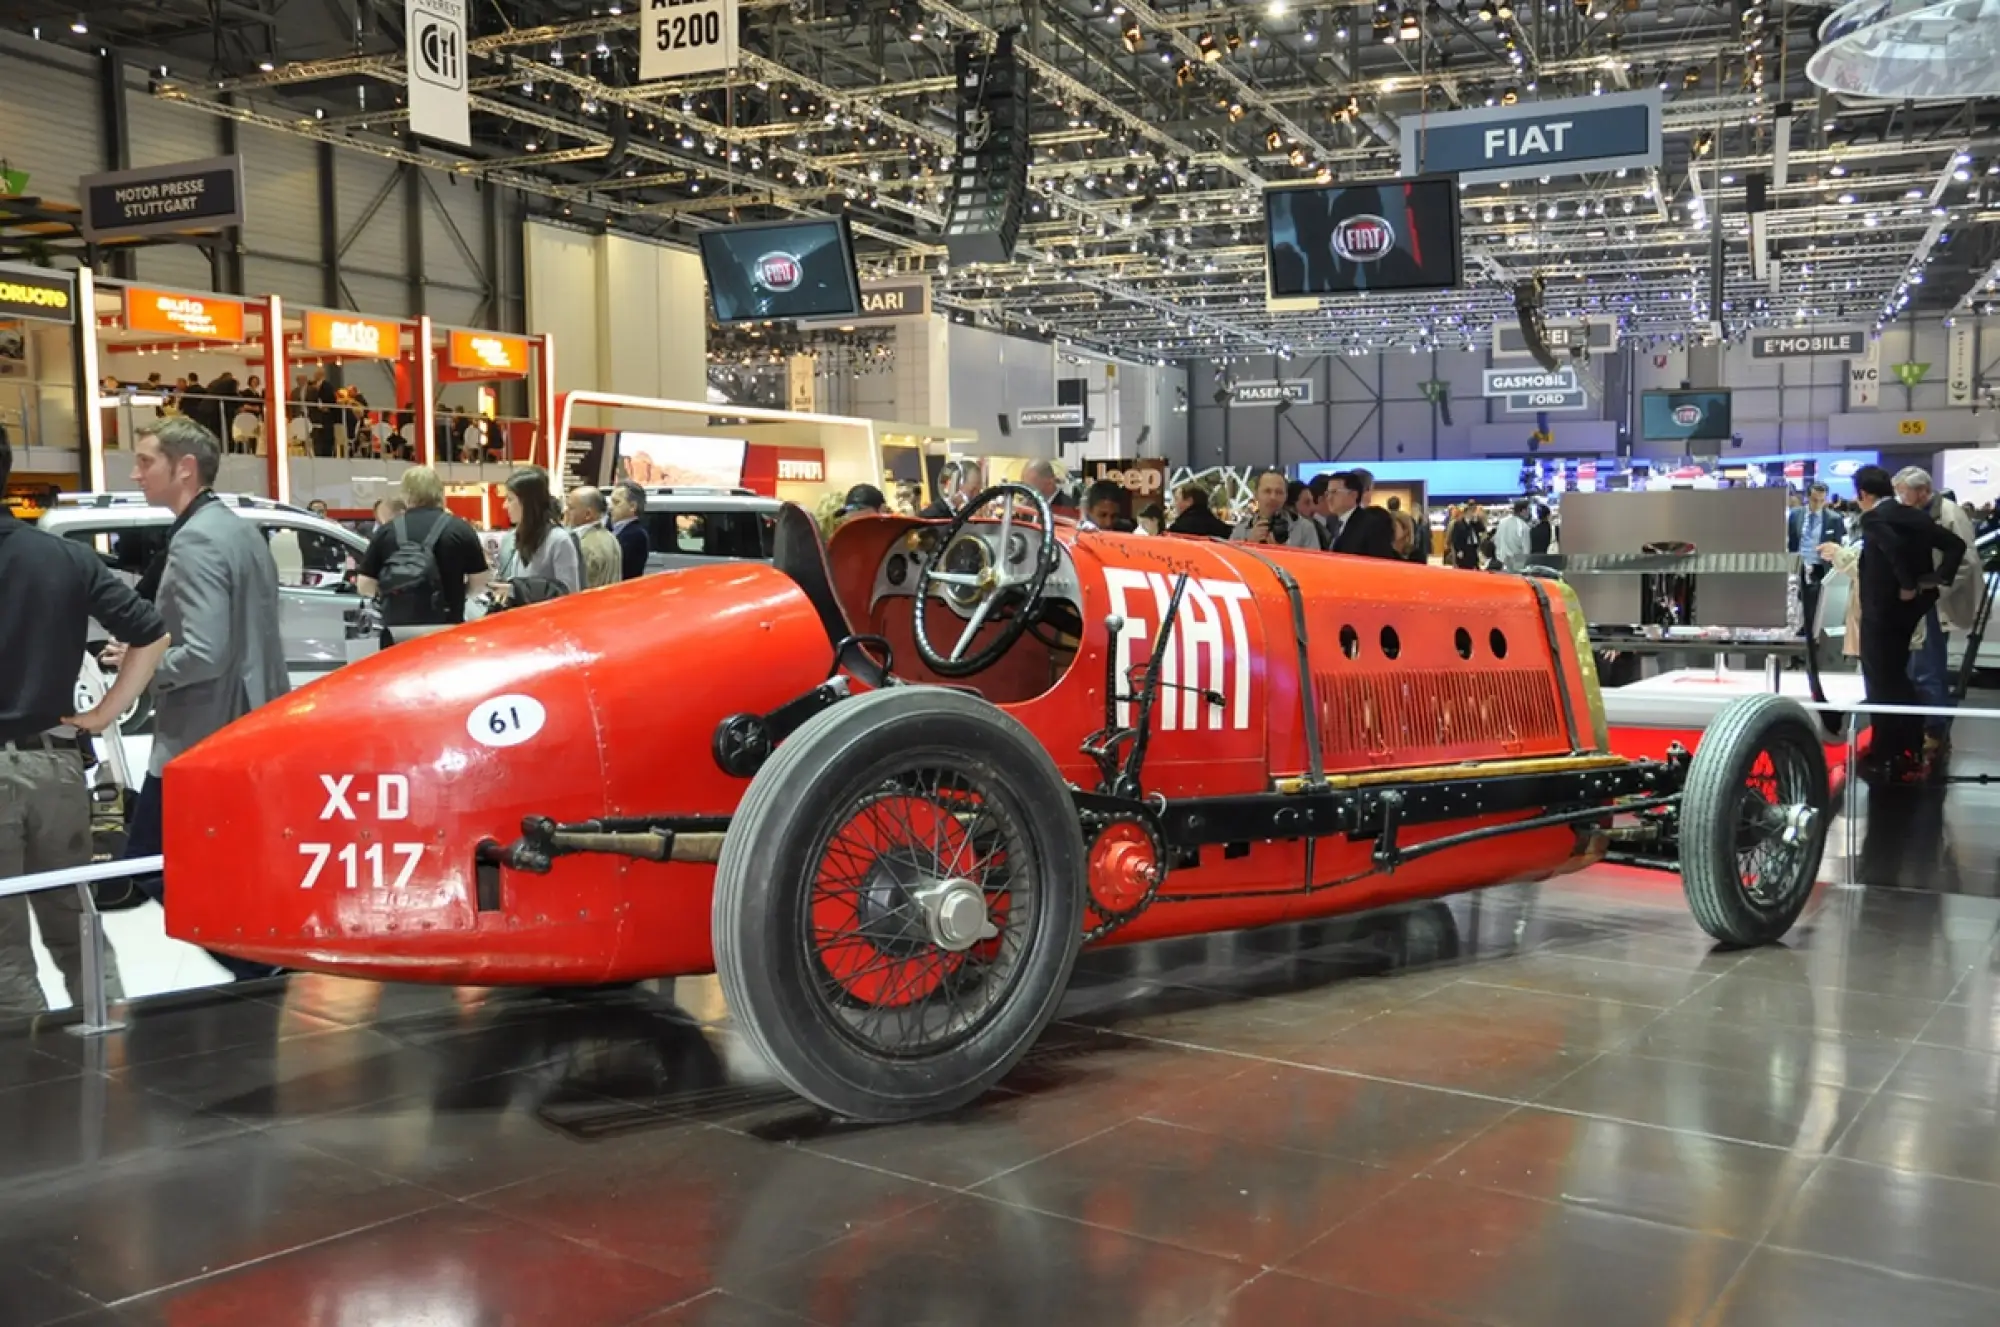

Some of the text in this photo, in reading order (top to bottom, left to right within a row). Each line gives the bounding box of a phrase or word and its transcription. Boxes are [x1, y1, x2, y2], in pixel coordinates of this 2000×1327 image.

[656, 10, 720, 50] 5200
[1484, 121, 1574, 160] FIAT
[115, 179, 205, 203] MOTOR PRESSE
[123, 196, 198, 218] STUTTGART
[1346, 227, 1382, 250] FIAT
[1763, 335, 1851, 353] E'MOBILE
[1493, 374, 1568, 389] GASMOBIL
[1851, 368, 1878, 381] WC
[1528, 394, 1565, 405] FORD
[1901, 420, 1922, 434] 55
[1102, 566, 1252, 731] FIAT
[489, 706, 521, 734] 61
[318, 774, 409, 821] X-D
[298, 843, 425, 889] 7117
